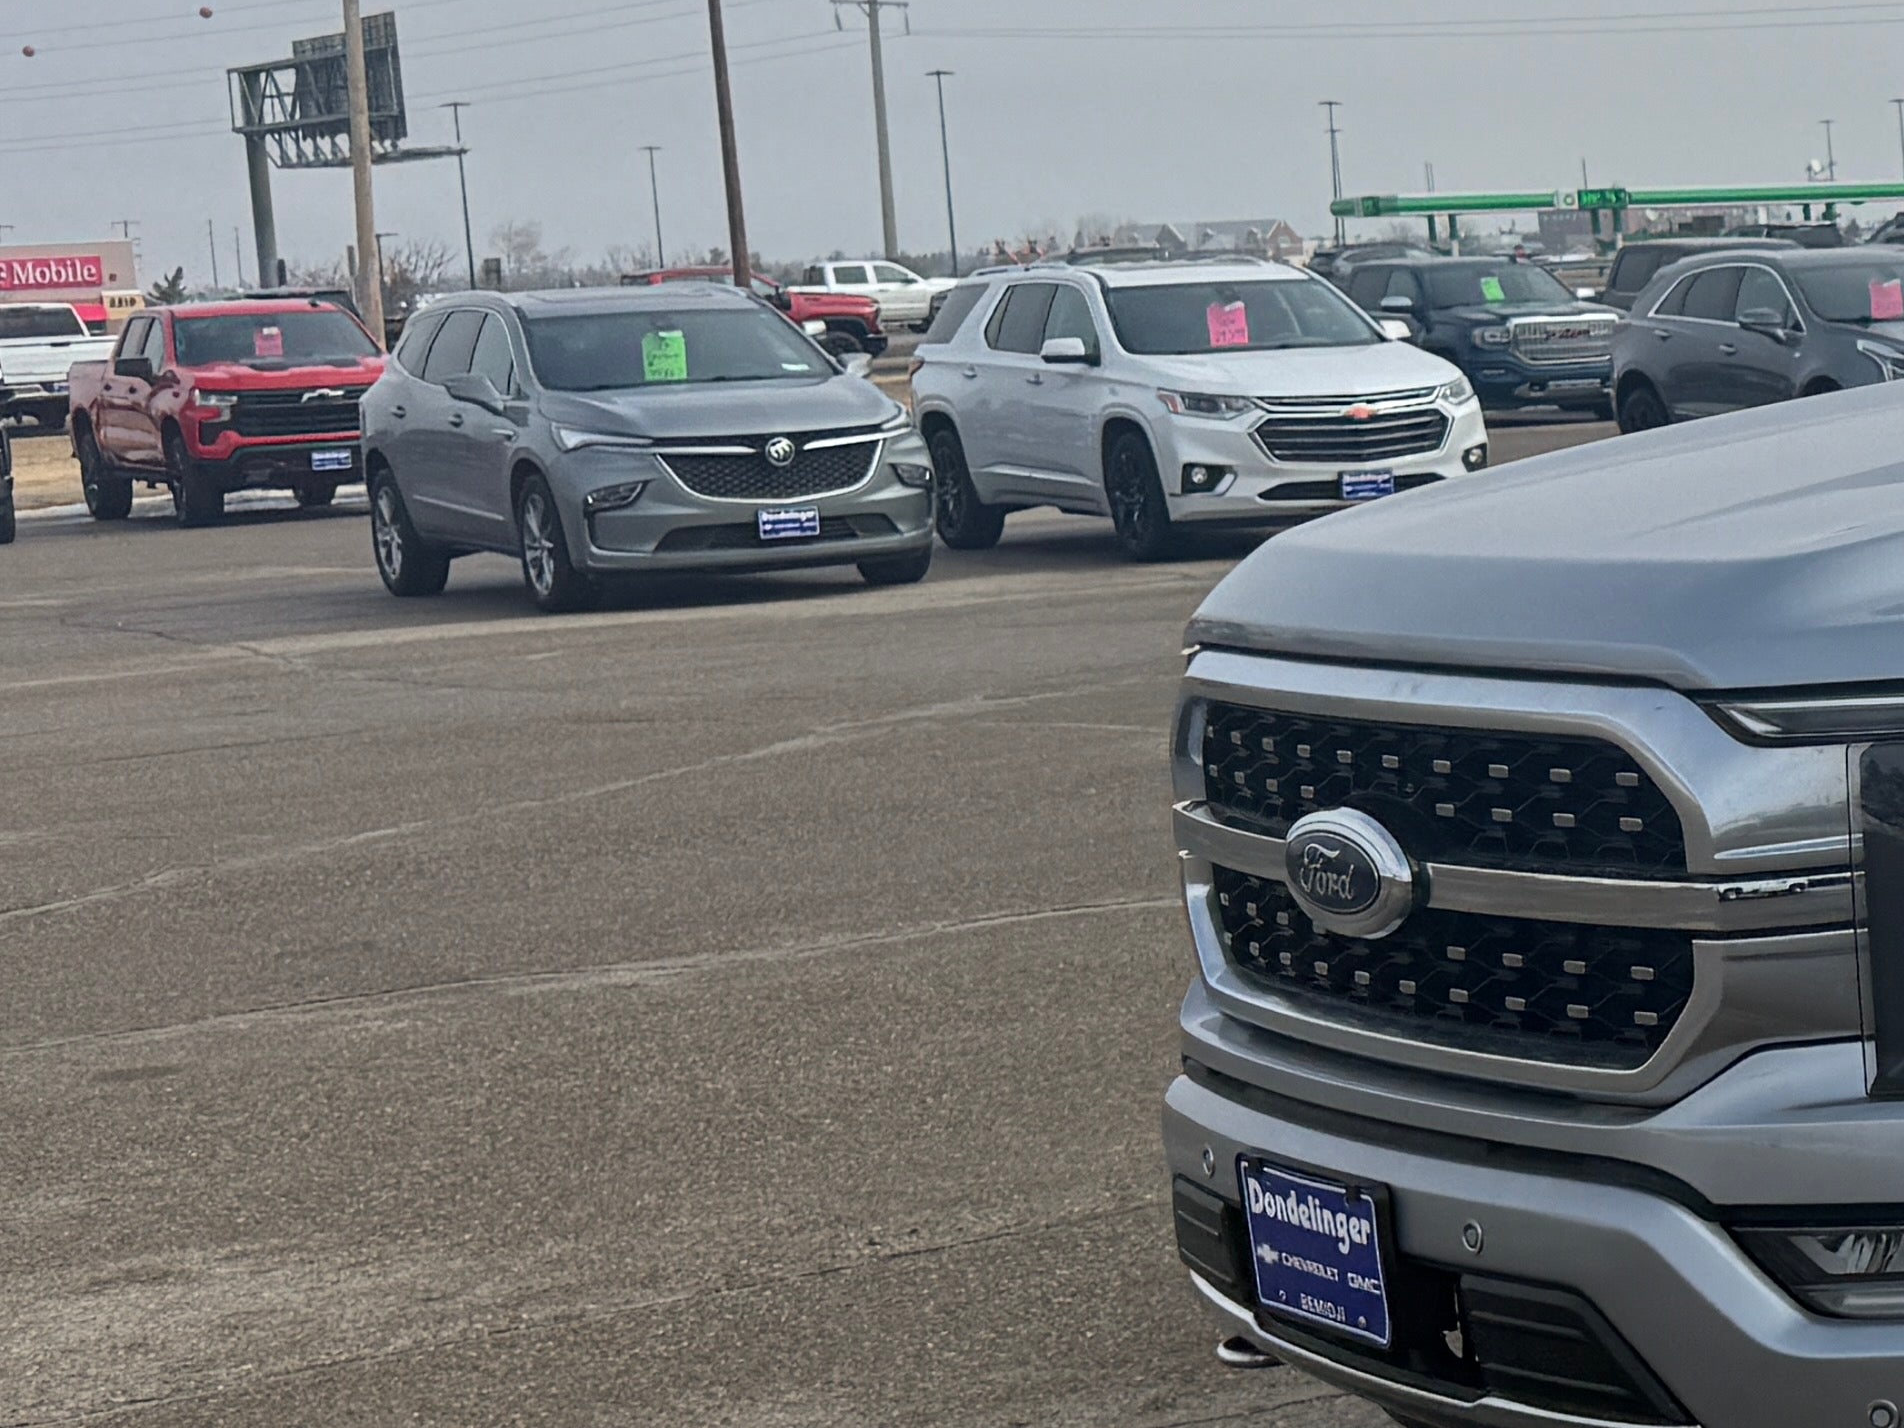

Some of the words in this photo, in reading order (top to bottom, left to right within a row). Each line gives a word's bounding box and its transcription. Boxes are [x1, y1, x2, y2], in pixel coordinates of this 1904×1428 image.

[12, 258, 97, 285] Mobile
[1300, 843, 1354, 900] Ford
[1247, 1177, 1371, 1255] Dondelinger
[1281, 1252, 1339, 1282] CHEVROLET
[1347, 1272, 1382, 1295] GMC
[1300, 1292, 1347, 1323] BEMIDJI
